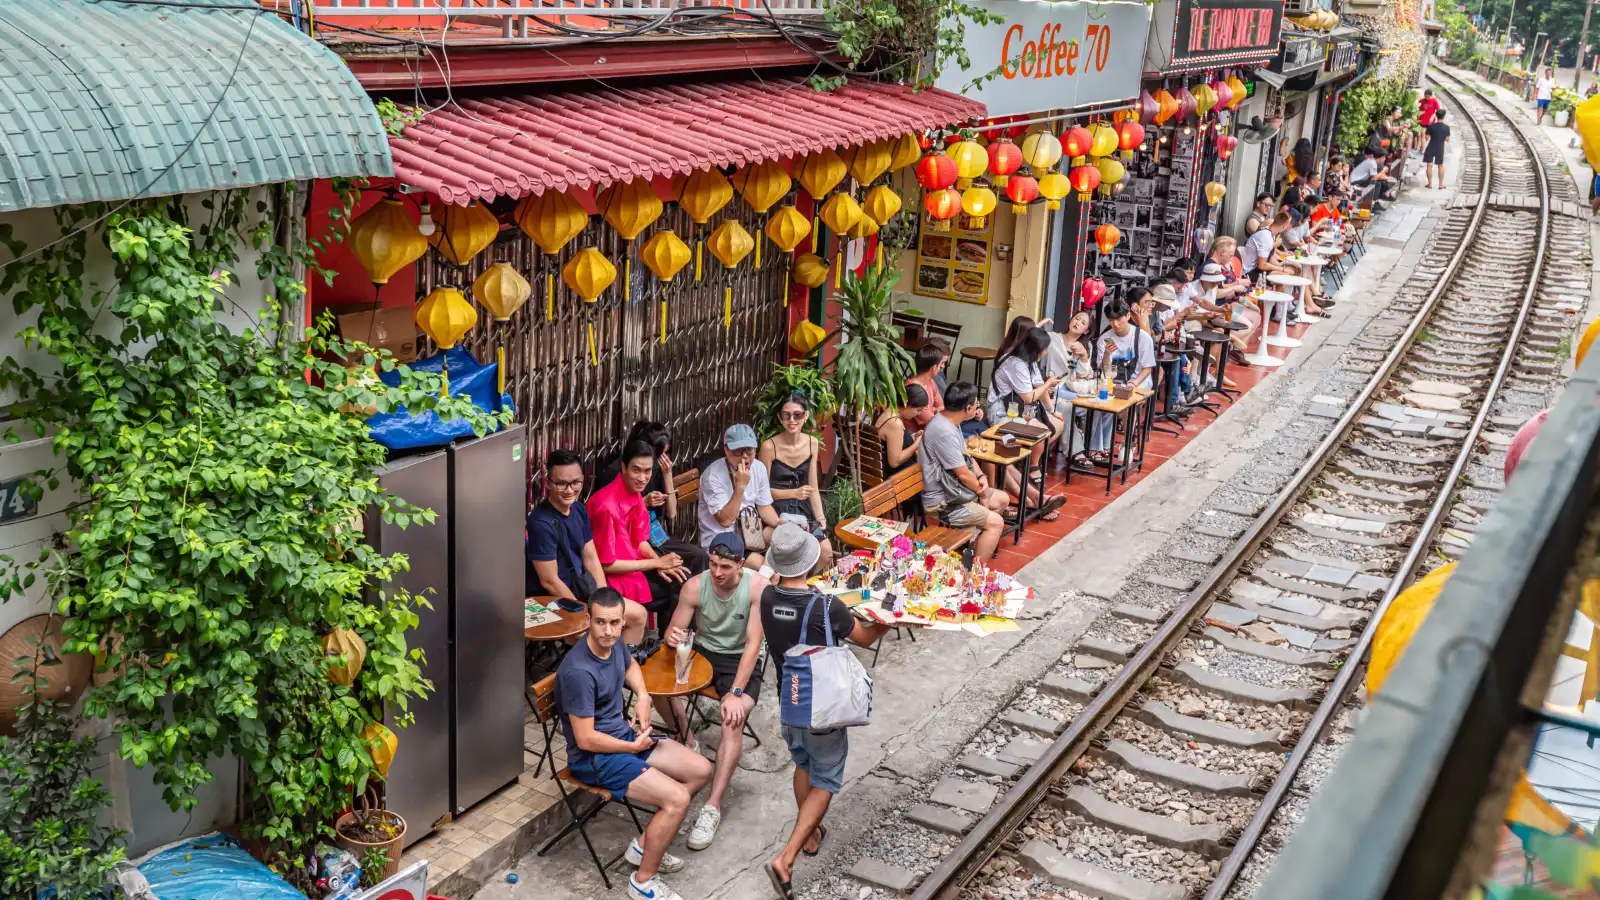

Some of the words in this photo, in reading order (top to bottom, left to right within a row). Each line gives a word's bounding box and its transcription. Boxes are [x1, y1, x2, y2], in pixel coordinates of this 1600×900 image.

[1001, 22, 1079, 80] Coffee
[1084, 24, 1111, 73] 70
[791, 673, 799, 705] UNCAGE
